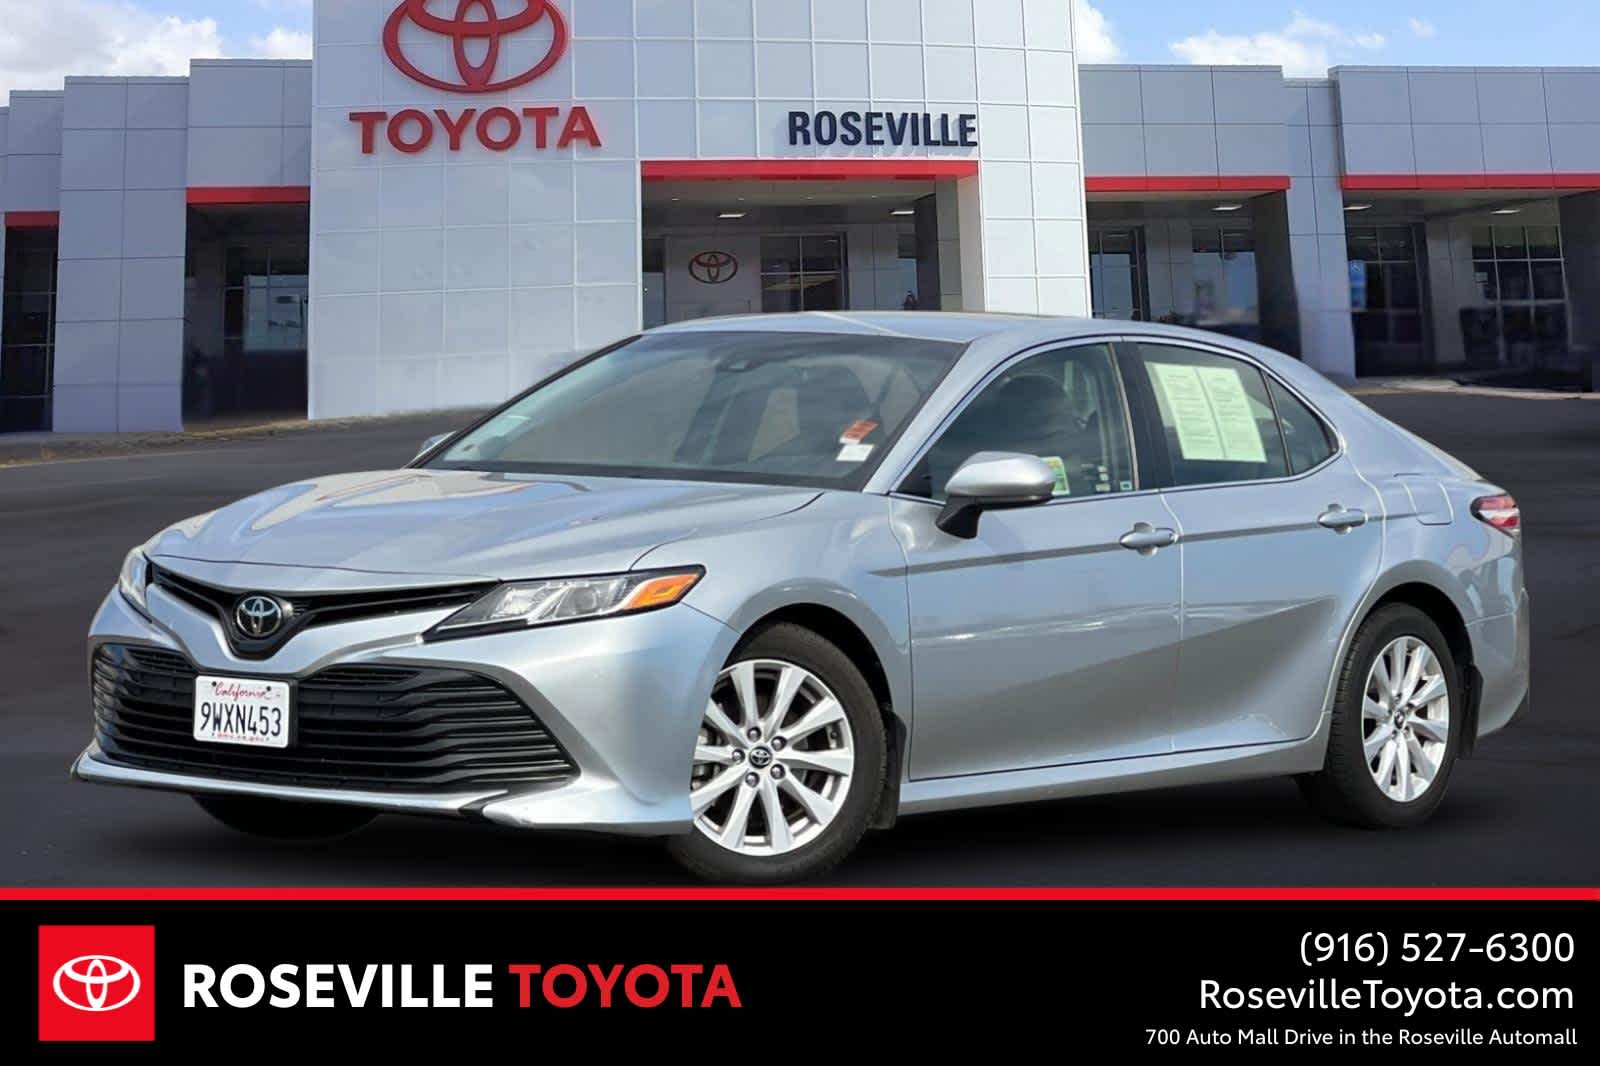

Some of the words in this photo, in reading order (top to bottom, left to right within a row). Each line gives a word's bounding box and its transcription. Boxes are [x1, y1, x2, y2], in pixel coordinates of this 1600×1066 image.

[349, 105, 602, 154] TOYOTA
[788, 110, 979, 148] ROSEVILLE
[214, 681, 268, 701] California
[200, 701, 282, 737] 9WXN453
